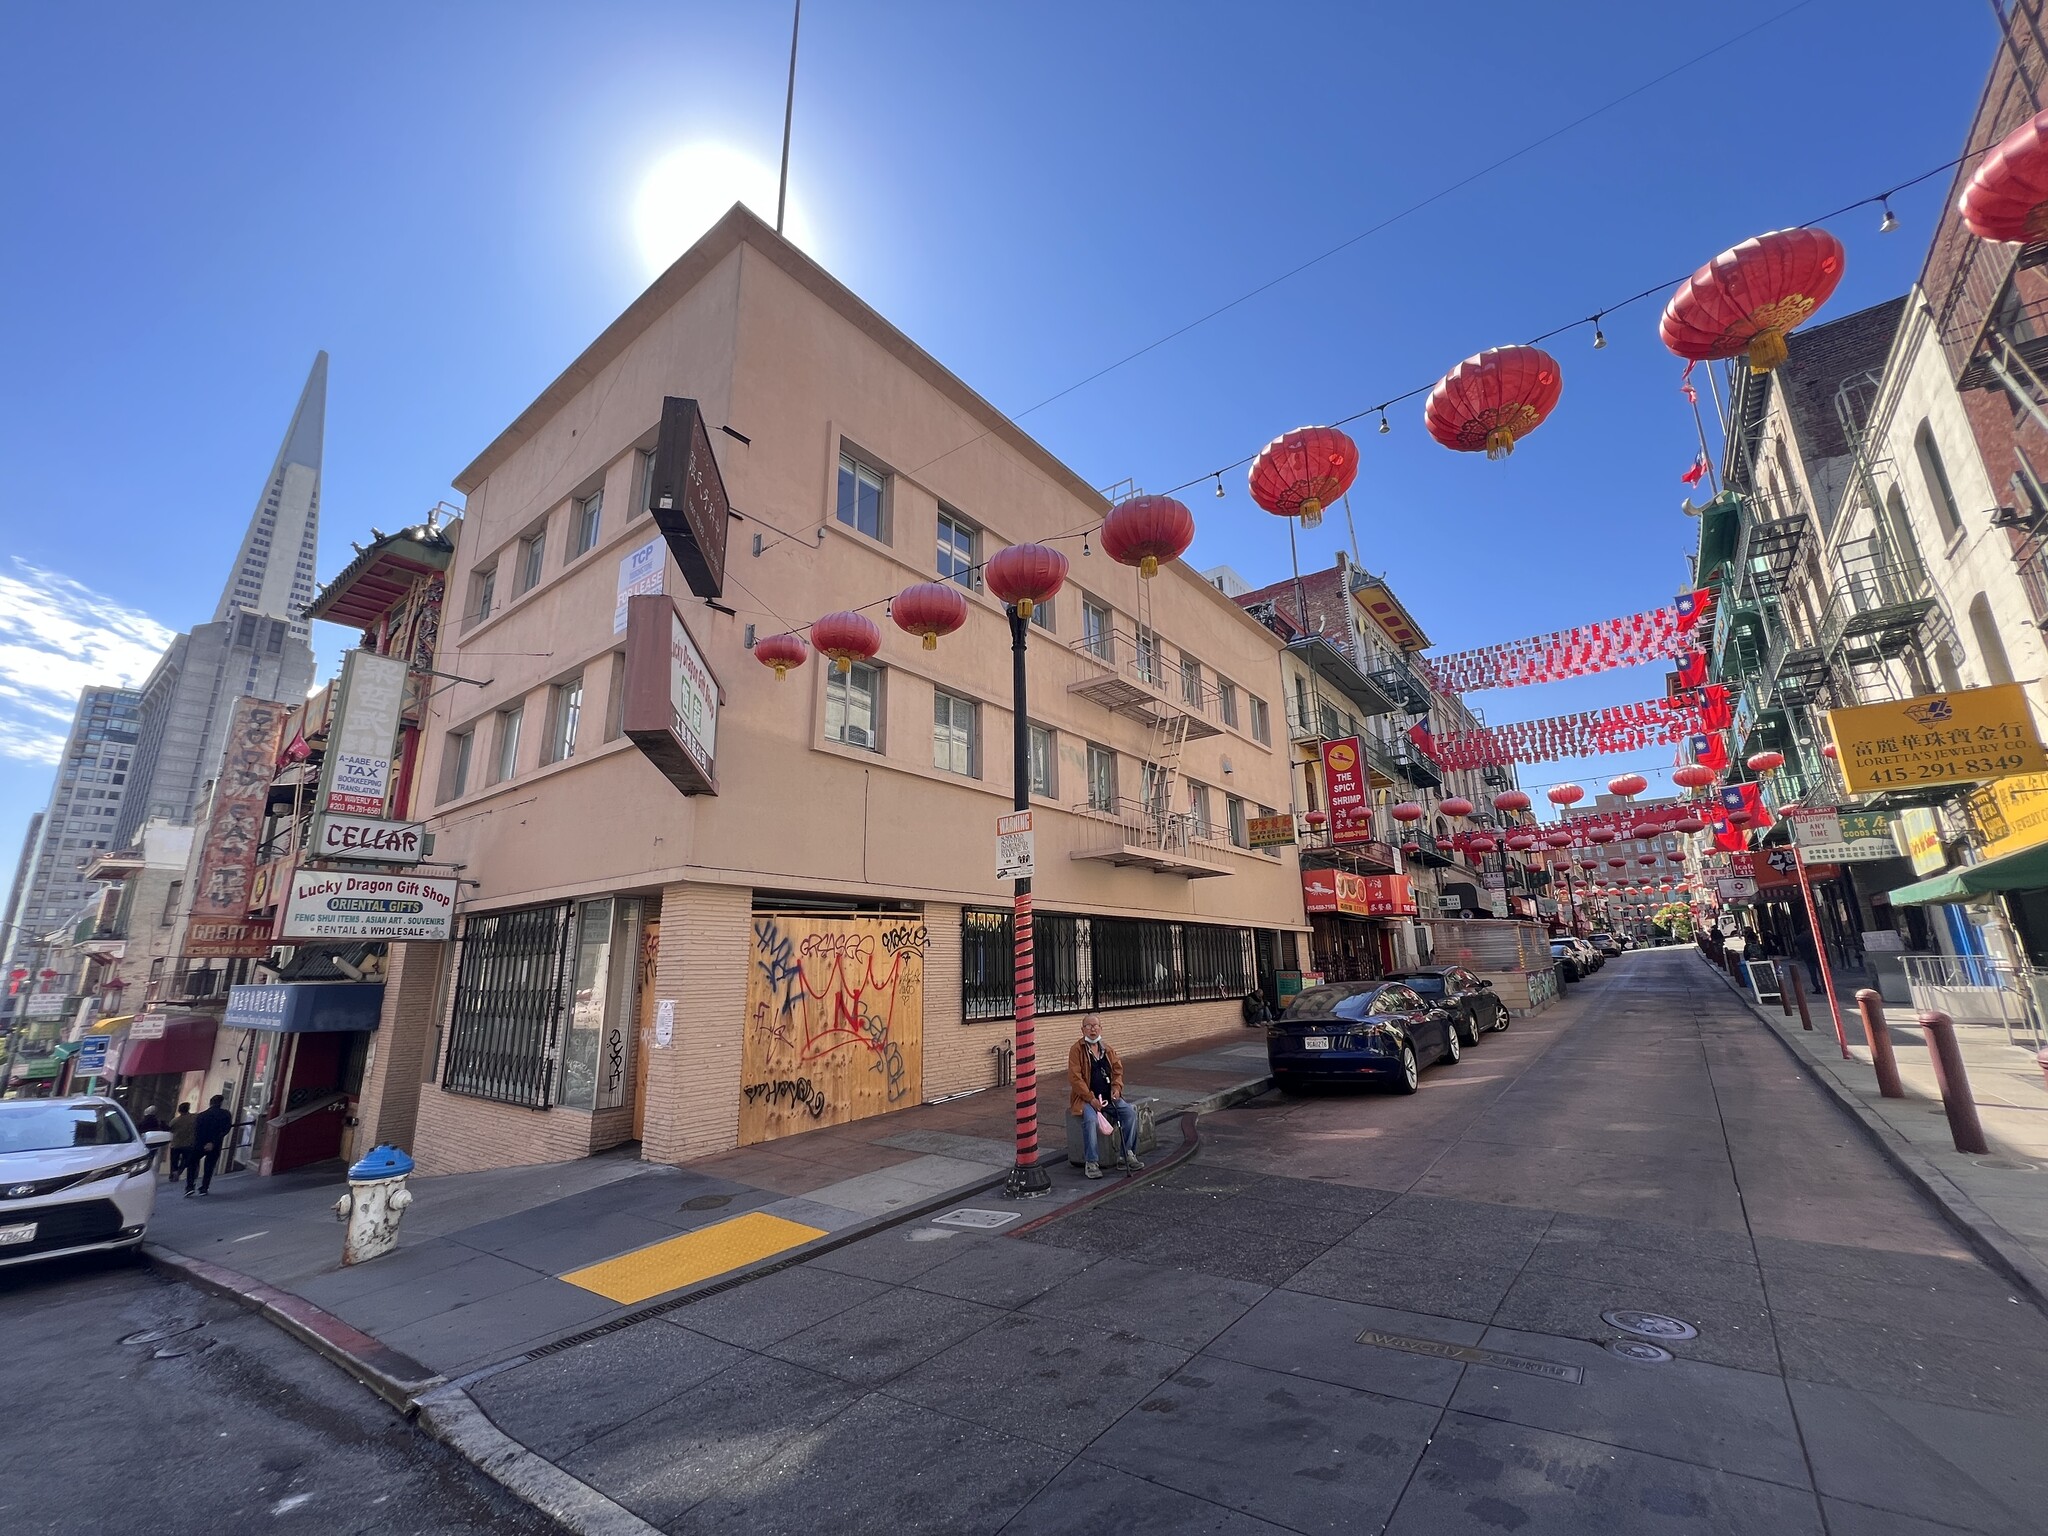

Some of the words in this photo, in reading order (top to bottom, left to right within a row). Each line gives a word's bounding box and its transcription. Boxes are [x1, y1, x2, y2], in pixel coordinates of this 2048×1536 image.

[631, 545, 654, 568] TCP
[634, 569, 663, 595] LEASE
[1856, 751, 1932, 768] LORETTA'S
[1935, 742, 1999, 761] JEWELRY
[2004, 740, 2032, 750] CO.
[338, 754, 371, 766] A-AABE
[374, 760, 388, 769] CO.
[344, 764, 379, 778] TAX
[1869, 754, 2024, 784] 415-291-8349
[338, 775, 382, 787] BOOKKEEPING
[1336, 772, 1352, 782] THE
[336, 783, 381, 795] TRANSLATION
[1333, 782, 1356, 793] SPICY
[329, 802, 345, 811] #203
[344, 795, 371, 805] WAVERLY
[1332, 794, 1361, 806] SHRIMP
[998, 813, 1030, 835] WARNING
[1795, 815, 1807, 823] NO
[1808, 813, 1836, 822] STOPPING
[326, 823, 419, 853] CELLAR
[1809, 830, 1828, 838] TIME
[1843, 829, 1870, 838] GOODS
[1872, 828, 1890, 836] STO
[299, 880, 343, 899] Lucky
[346, 878, 393, 894] Dragon
[396, 880, 419, 896] Gift
[422, 885, 450, 907] Shop
[330, 898, 386, 912] ORIENTAL
[389, 901, 420, 913] GIFTS
[294, 913, 315, 922] FENG
[316, 914, 336, 923] SHUI
[336, 915, 360, 923] ITEMS
[365, 916, 388, 924] ASIAN
[388, 916, 403, 924] ART
[407, 917, 445, 926] SOUVENIRS
[191, 924, 249, 941] GREAT
[316, 925, 358, 935] RENTAIL
[360, 926, 367, 935] &
[370, 926, 425, 937] WHOLESALE
[1372, 1333, 1464, 1357] Waverly
